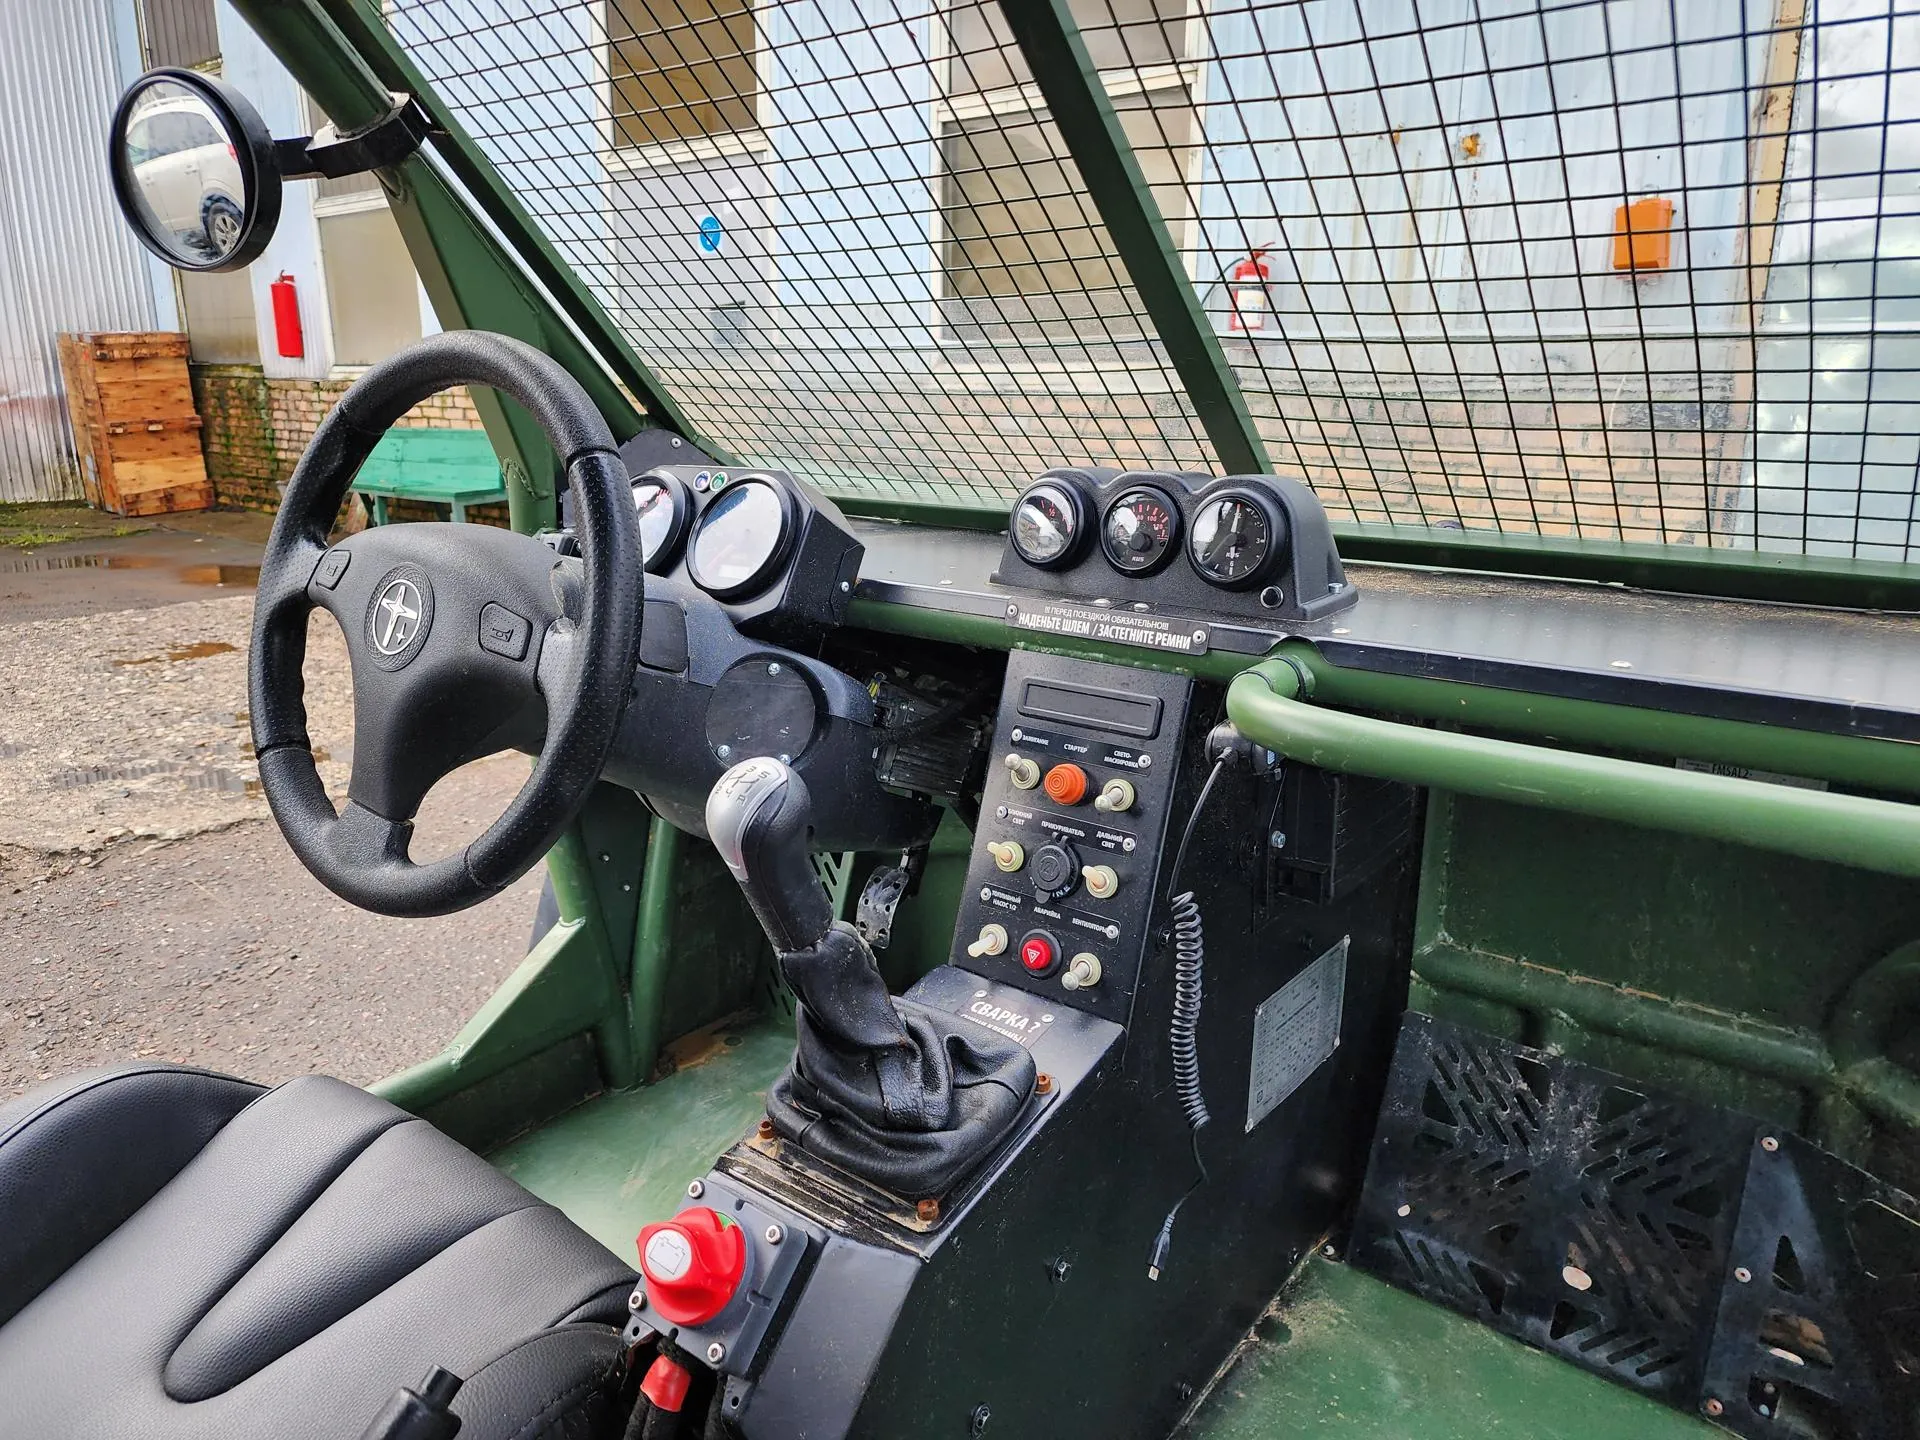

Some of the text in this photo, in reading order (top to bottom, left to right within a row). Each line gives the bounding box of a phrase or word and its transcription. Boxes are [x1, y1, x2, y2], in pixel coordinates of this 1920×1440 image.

[1051, 607, 1073, 618] ПЕРЕД
[1073, 609, 1111, 622] ПОЕЗДКОЙ
[1018, 612, 1062, 631] НАДЕНЬТЕ
[1061, 619, 1091, 636] ШЛЕМ
[1098, 624, 1155, 645] ЗАСТЕГНИТЕ
[1155, 633, 1192, 651] РЕМНИ
[1063, 743, 1088, 754] СТАРТЕР
[1012, 817, 1025, 825] СВЕТ
[1041, 820, 1086, 837] ПРИКУРИВАТЕЛЬ
[1096, 830, 1124, 843] ДАЛЬНИЙ
[1101, 840, 1116, 849] СВЕТ
[1033, 906, 1061, 920] АВАРИЙКА
[970, 1001, 1041, 1034] СВАРКА ?
